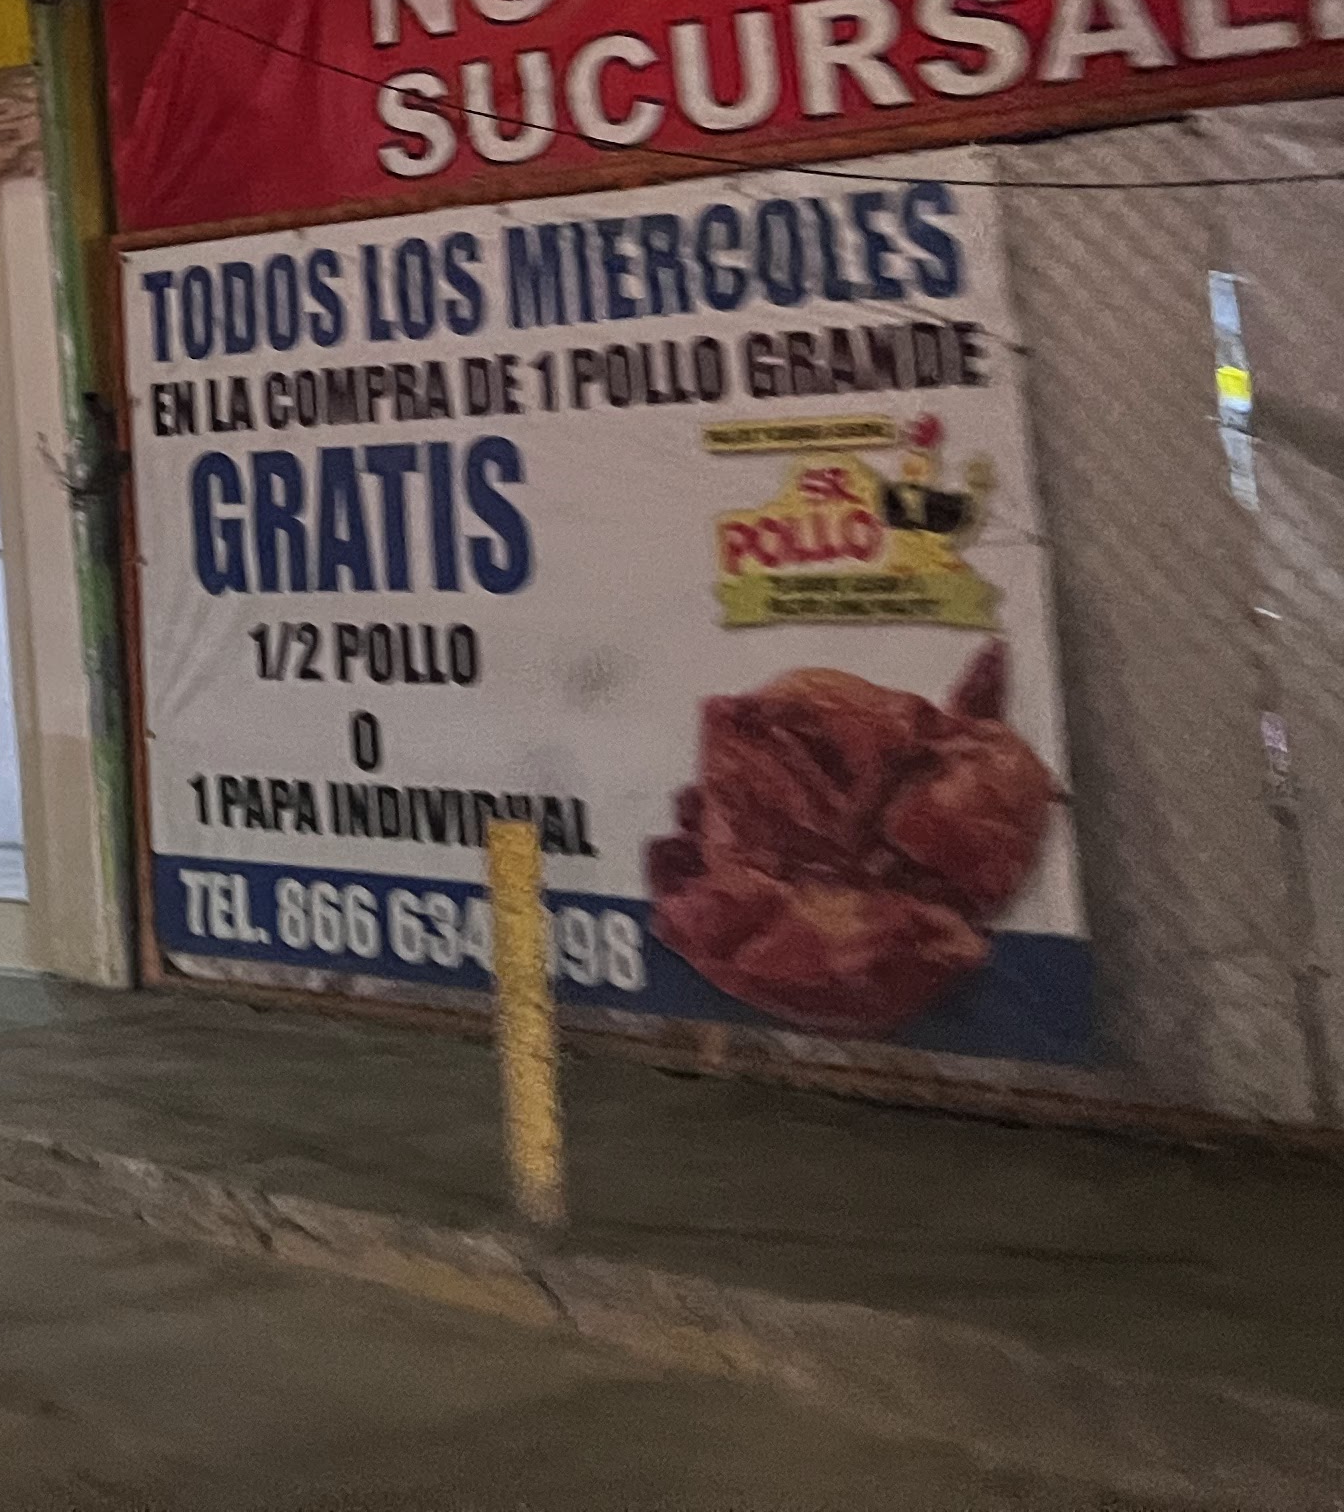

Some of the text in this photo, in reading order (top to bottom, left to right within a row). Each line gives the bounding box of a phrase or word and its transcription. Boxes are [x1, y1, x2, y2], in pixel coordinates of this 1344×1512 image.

[142, 181, 961, 363] TODOS LOS MIERCOLES
[150, 321, 988, 438] EN LA COMPRA DE 1 POLLO GRANDE
[190, 435, 534, 598] GRATIS
[249, 622, 481, 685] 1/2 POLLO
[188, 772, 210, 826] 1
[218, 774, 323, 836] PAPA
[179, 868, 272, 944] TEL.
[274, 877, 382, 959] 866
